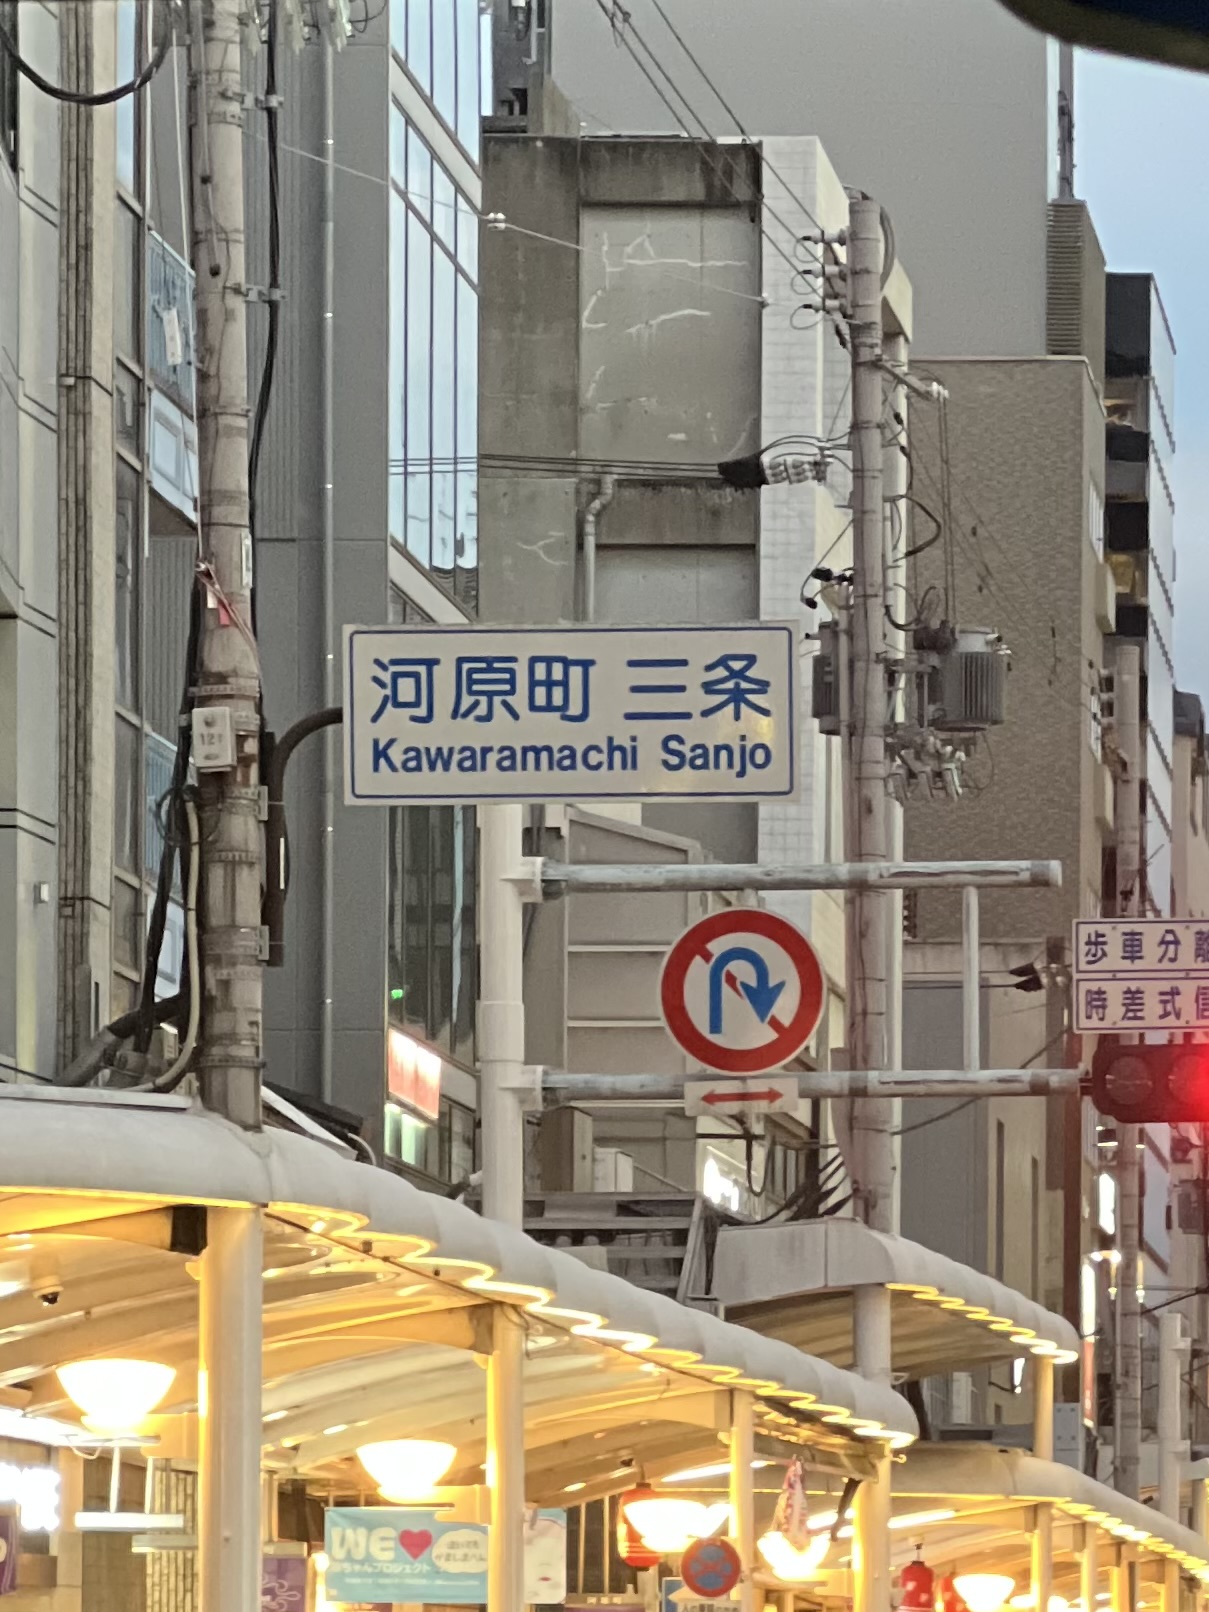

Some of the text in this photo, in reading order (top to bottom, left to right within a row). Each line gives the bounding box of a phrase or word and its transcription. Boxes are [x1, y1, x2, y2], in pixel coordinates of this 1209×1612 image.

[370, 653, 772, 724] 河原町 三条
[371, 734, 772, 778] Kawaramachi Sanjo
[330, 1527, 397, 1561] WE
